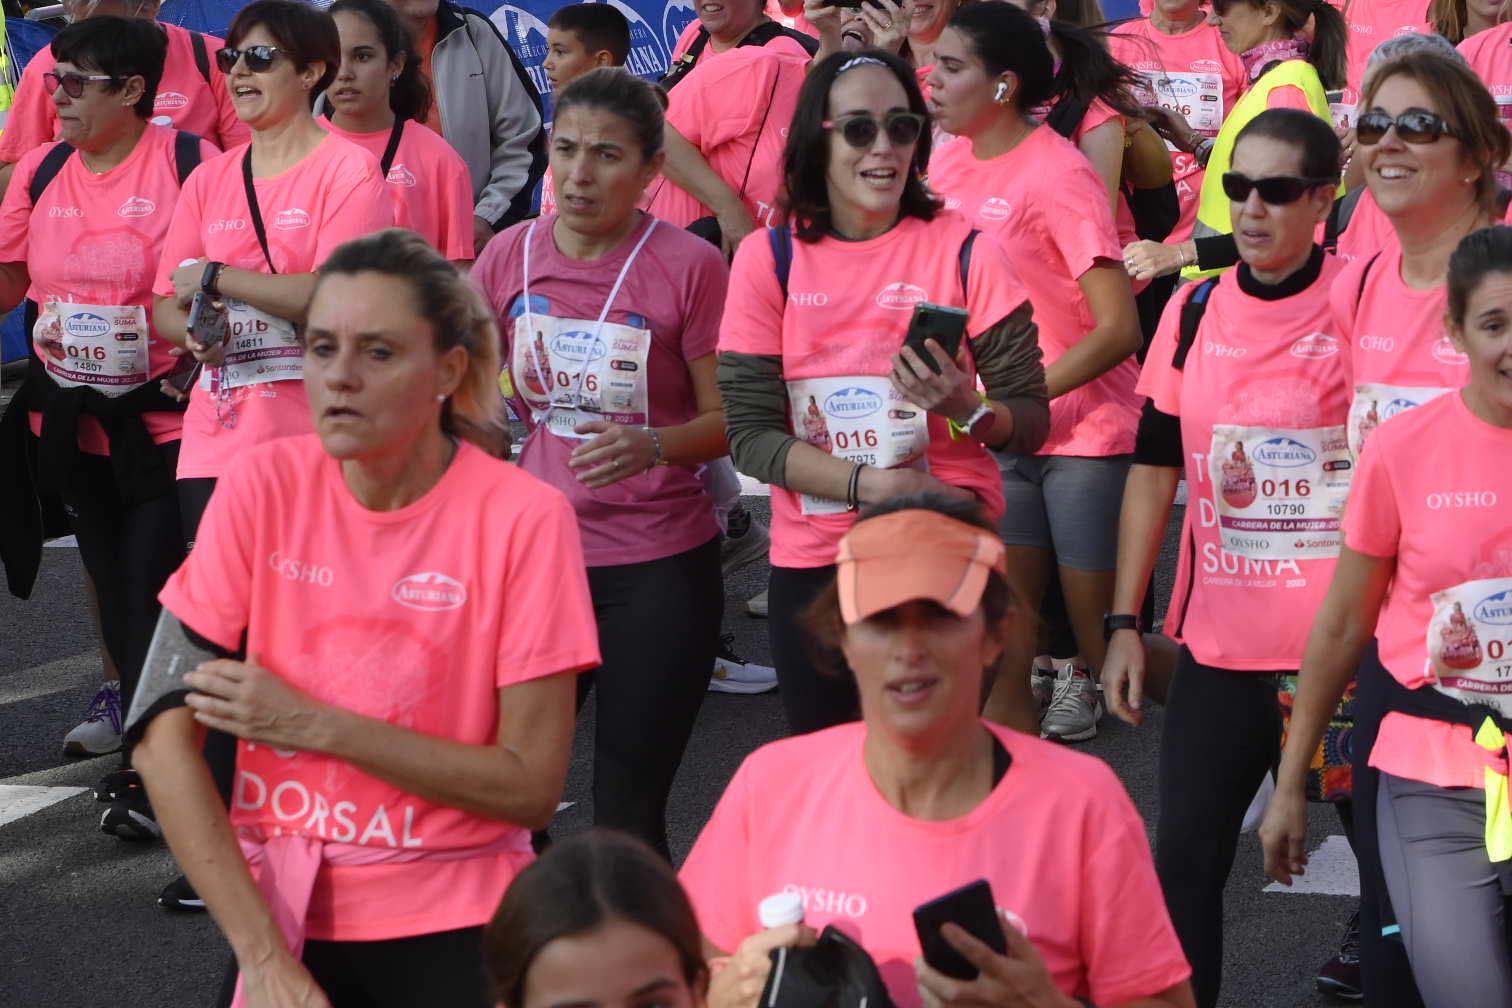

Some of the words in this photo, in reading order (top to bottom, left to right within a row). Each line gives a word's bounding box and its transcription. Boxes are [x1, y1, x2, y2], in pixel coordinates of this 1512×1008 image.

[233, 320, 268, 335] 016
[67, 346, 106, 360] 016
[74, 362, 102, 372] 14807
[827, 399, 877, 413] ASTURIANA
[835, 429, 878, 449] 016
[1258, 449, 1312, 460] ASTURIANA
[1262, 479, 1311, 497] 016
[1426, 491, 1496, 510] OYSHO
[1267, 504, 1305, 515] 10790
[1232, 521, 1268, 529] CARRERA
[1231, 536, 1269, 549] OYSHO
[1456, 679, 1498, 692] CARRERA
[1500, 683, 1512, 691] DE
[236, 770, 424, 849] DORSAL
